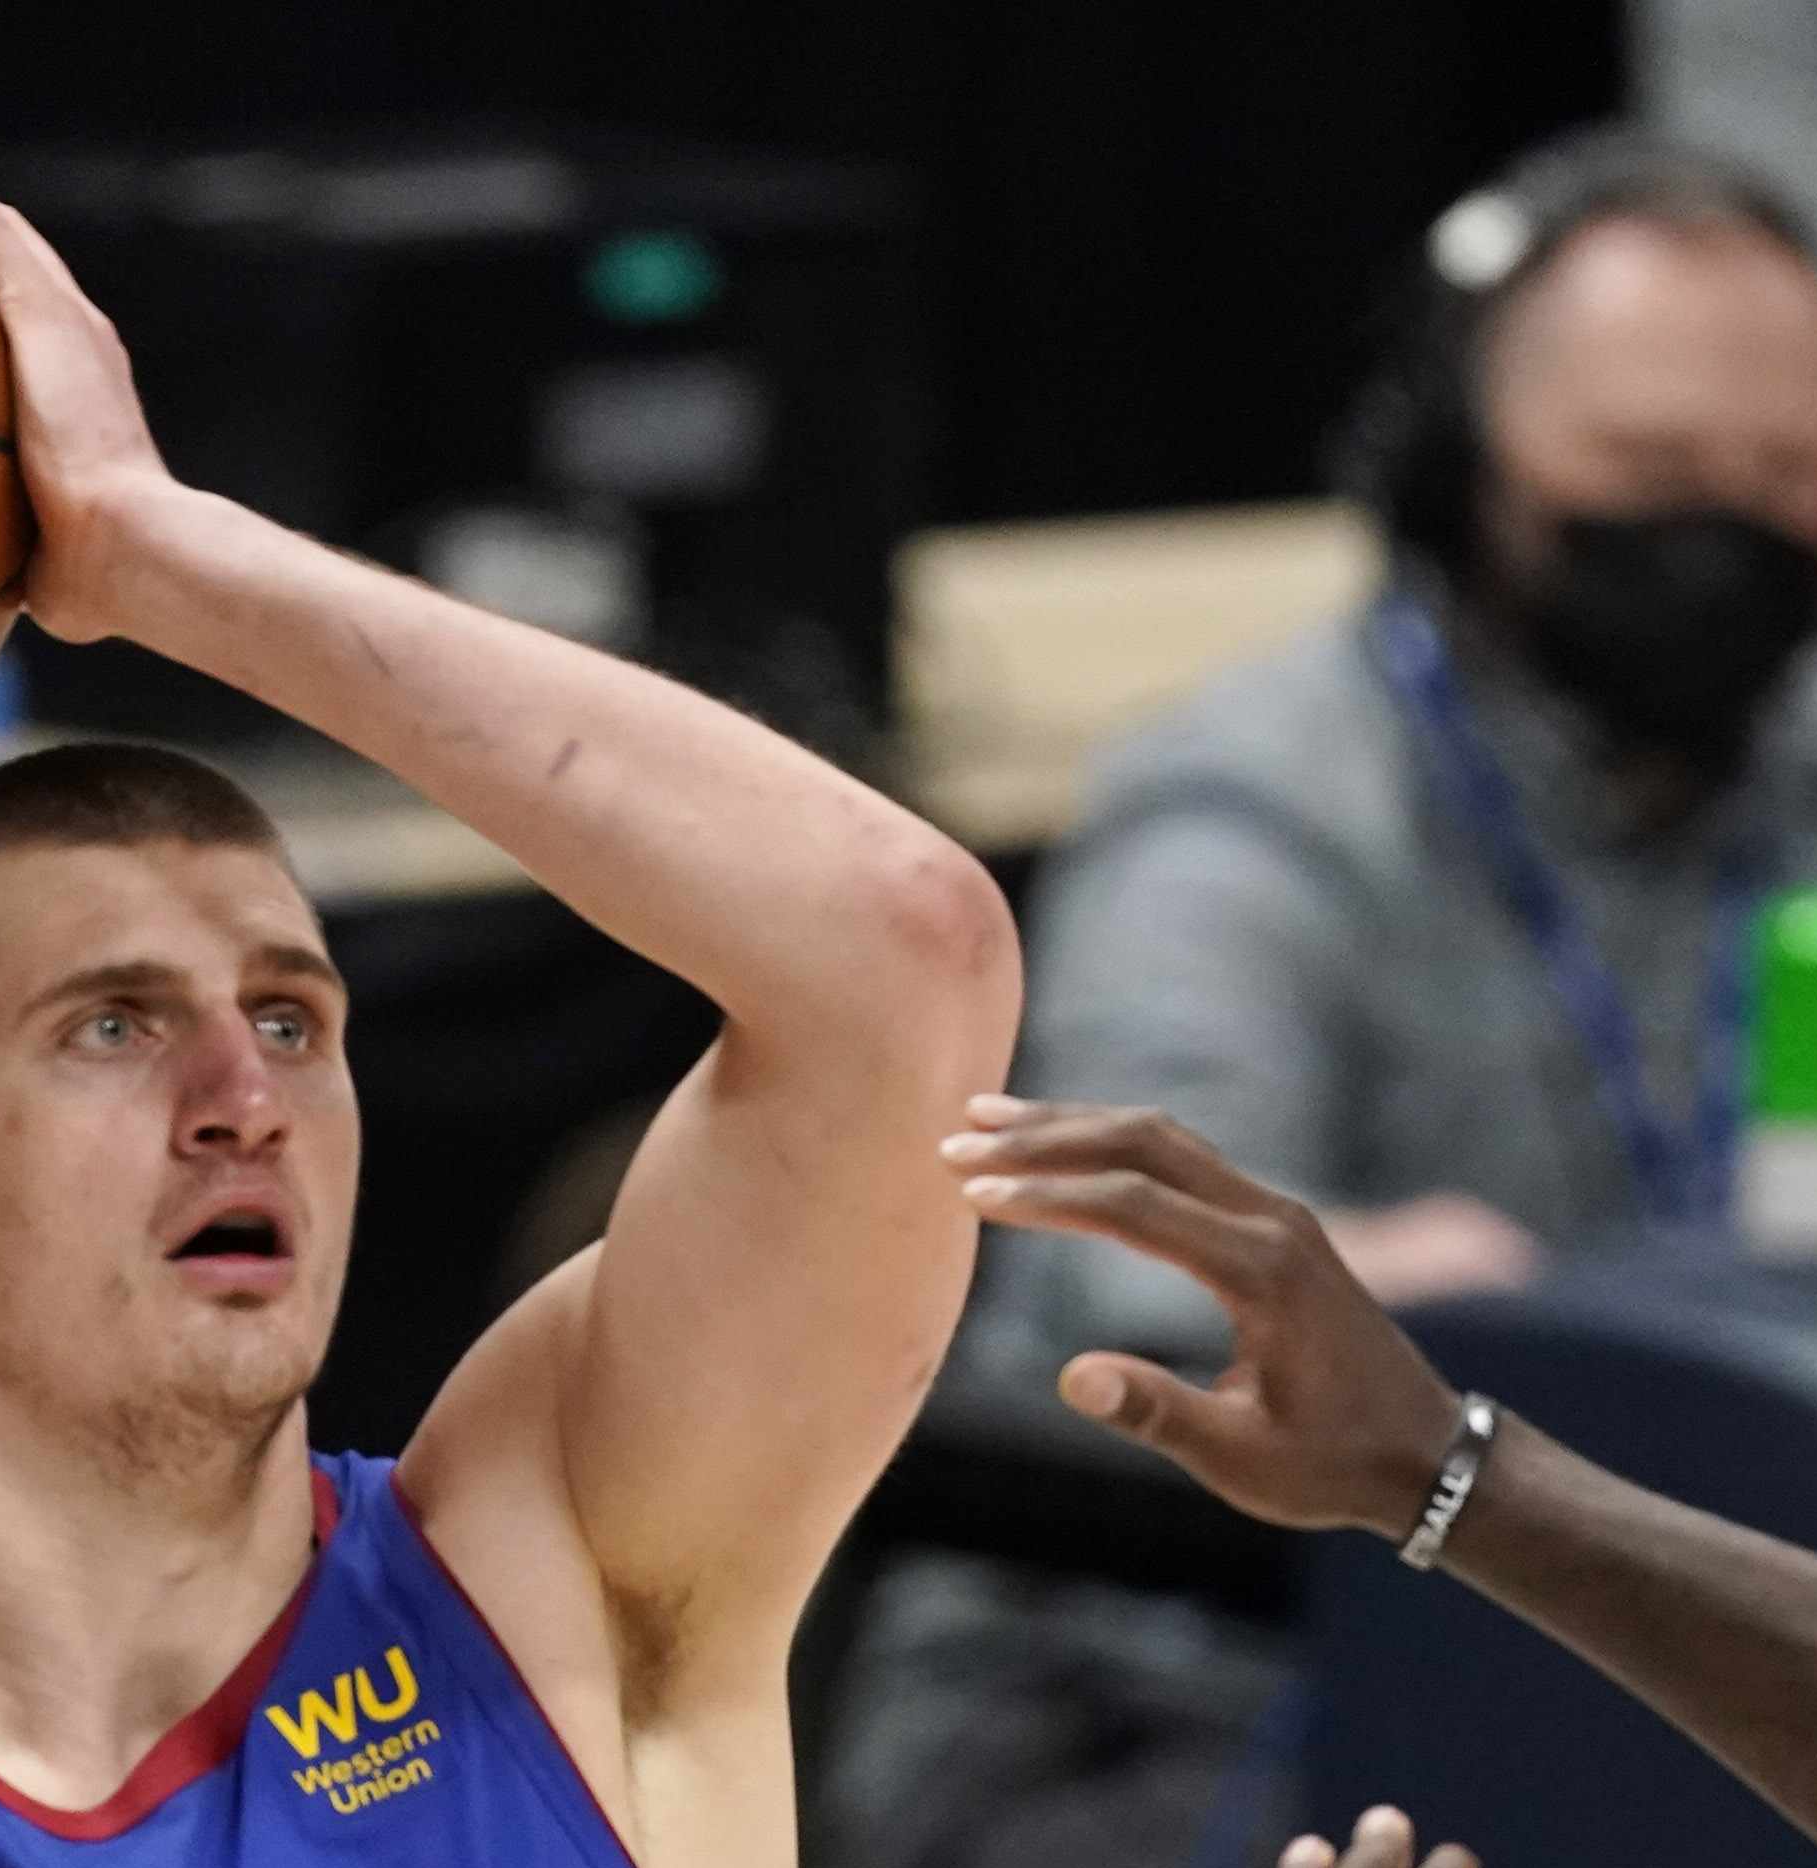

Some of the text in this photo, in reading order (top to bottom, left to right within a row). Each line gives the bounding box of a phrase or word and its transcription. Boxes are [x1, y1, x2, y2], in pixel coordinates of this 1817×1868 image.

[264, 1645, 419, 1759] WU
[292, 1719, 442, 1795] Western
[328, 1757, 433, 1814] Union
